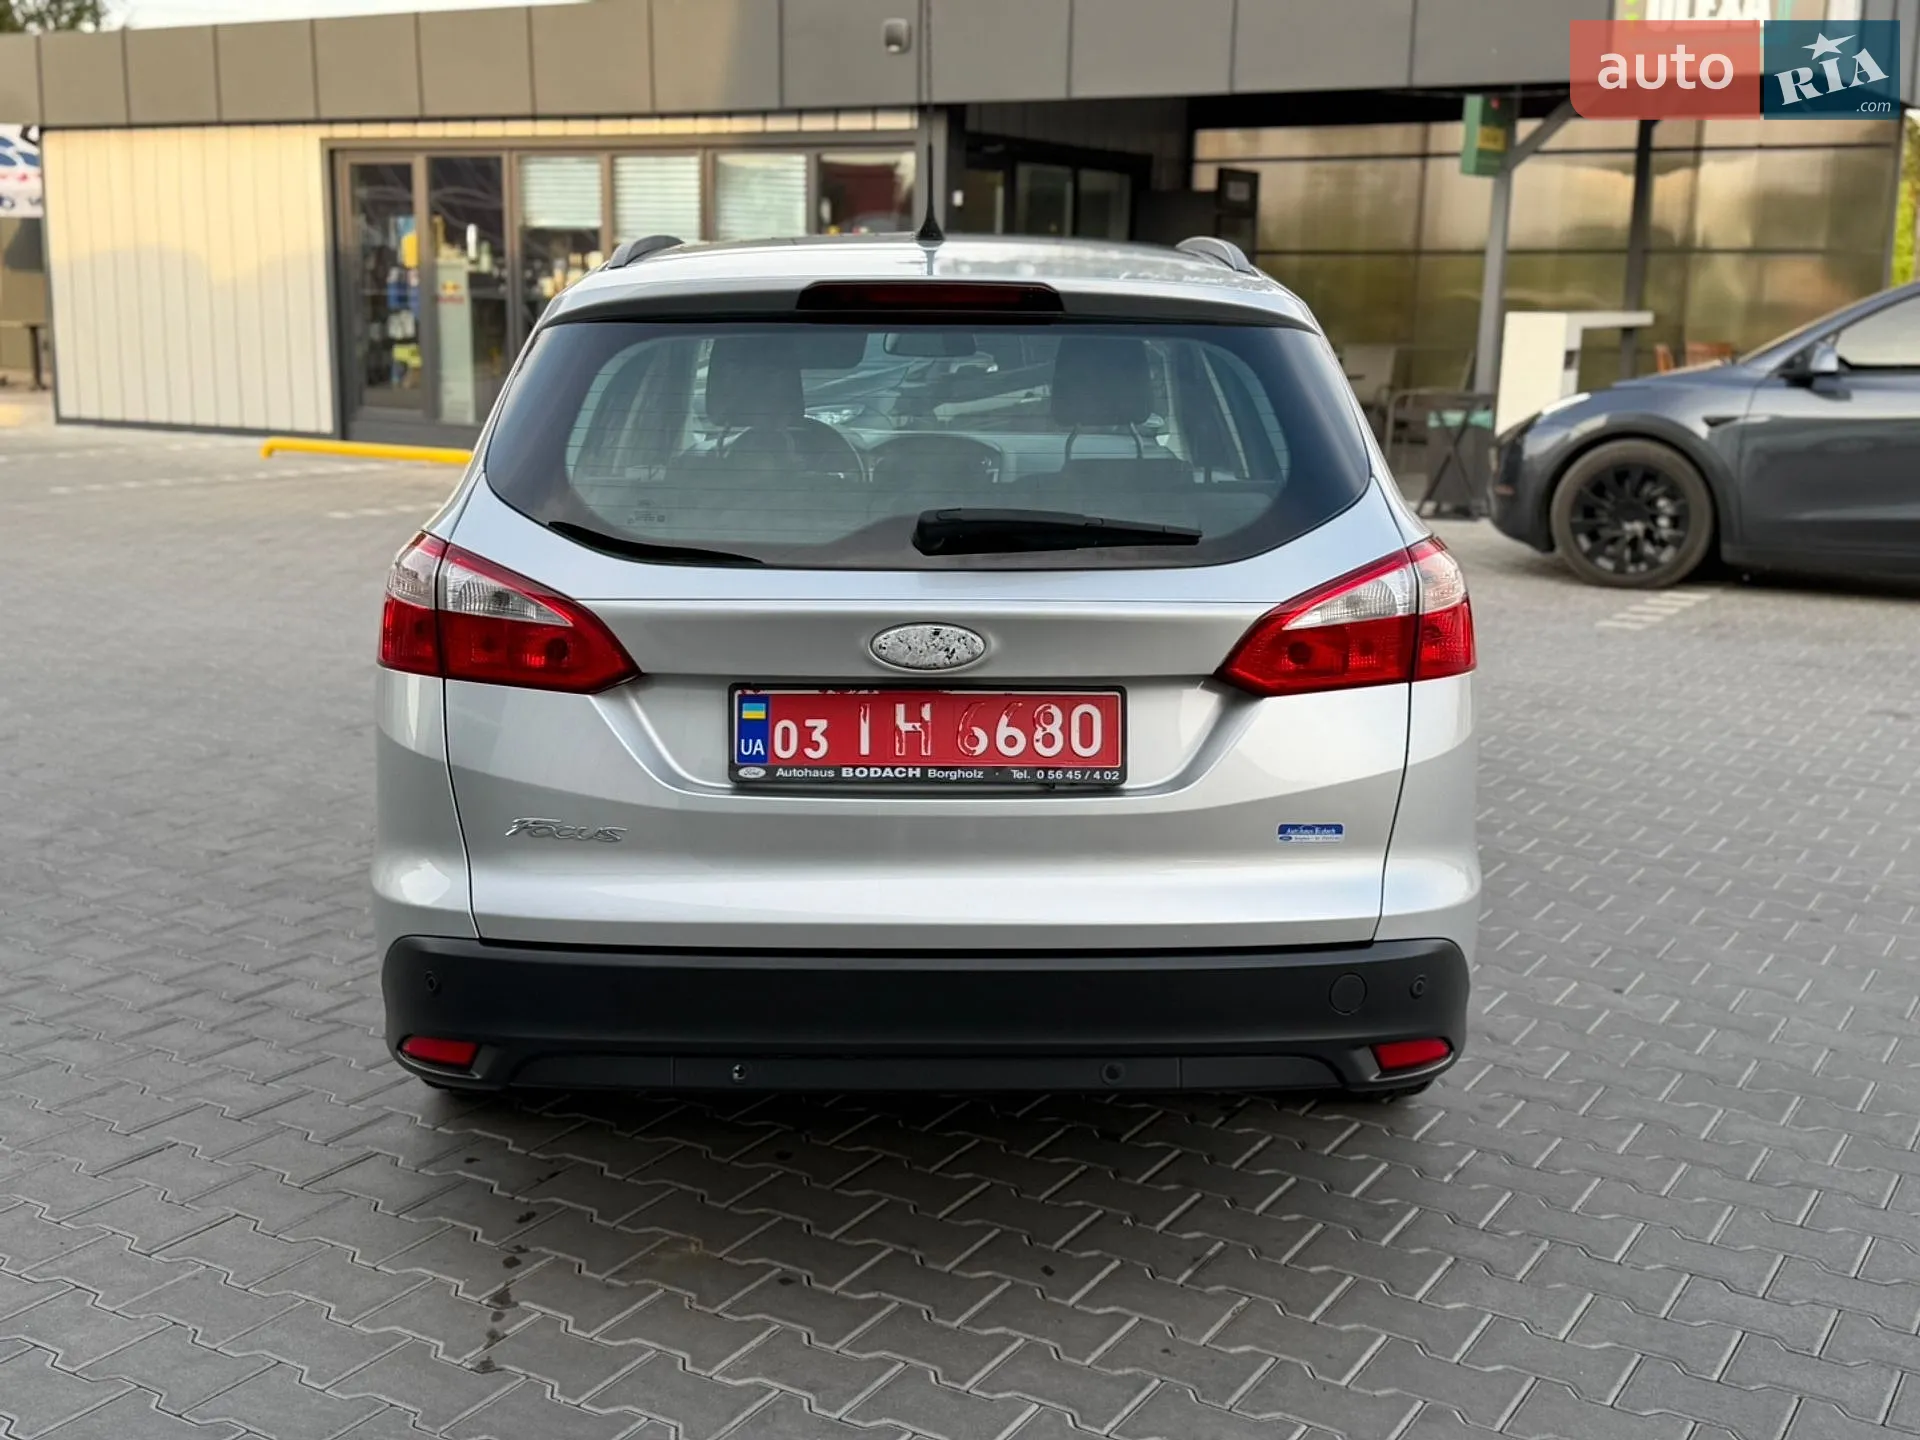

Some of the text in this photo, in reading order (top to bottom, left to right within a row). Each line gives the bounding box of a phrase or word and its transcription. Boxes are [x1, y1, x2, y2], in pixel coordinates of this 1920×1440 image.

[773, 718, 829, 759] 03
[957, 702, 1103, 758] 6680
[740, 738, 765, 756] UA
[775, 767, 835, 778] Autohaus
[841, 767, 921, 778] BODACH
[927, 769, 984, 781] Borgholz
[1010, 769, 1031, 779] Tel.
